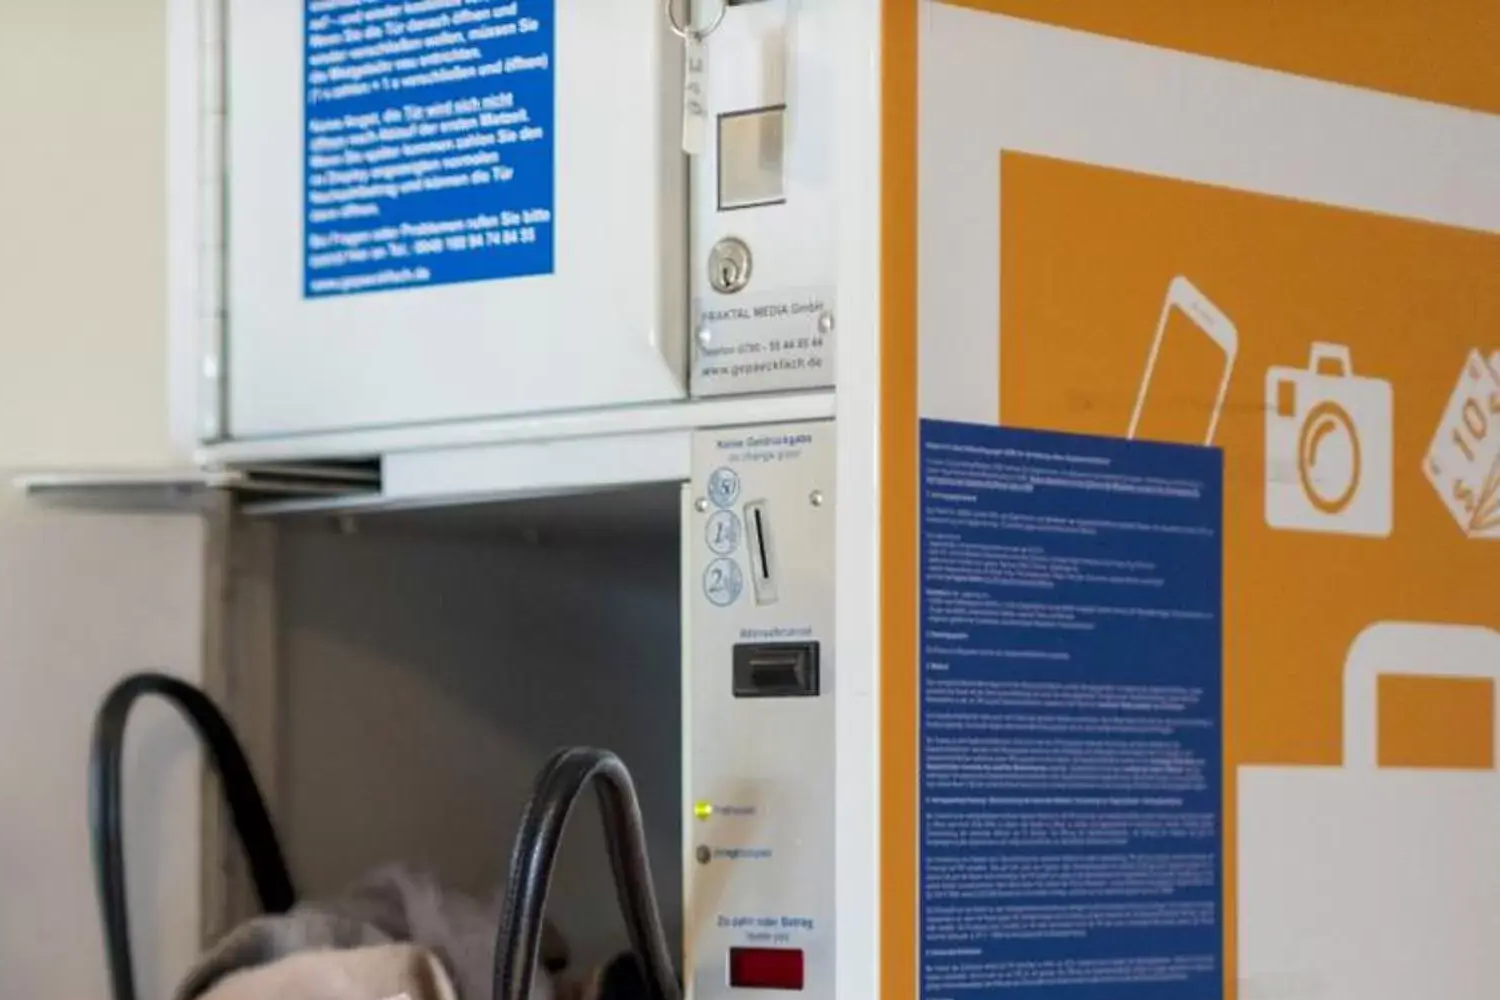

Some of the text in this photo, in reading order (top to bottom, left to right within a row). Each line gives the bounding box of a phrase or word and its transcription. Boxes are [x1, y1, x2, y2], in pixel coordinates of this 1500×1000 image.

[492, 3, 517, 17] und
[468, 24, 516, 39] müssen
[518, 18, 538, 32] Sie
[477, 61, 502, 76] und
[504, 55, 548, 72] öffnen)
[383, 109, 401, 122] die
[404, 106, 426, 120] Tür
[425, 101, 453, 117] wird
[454, 98, 481, 113] sich
[482, 93, 513, 109] nicht
[418, 124, 440, 135] der
[439, 118, 478, 132] ersten
[343, 151, 365, 164] Sie
[456, 134, 497, 149] zahlen
[496, 130, 518, 143] Sie
[519, 127, 542, 140] den
[400, 178, 423, 191] und
[470, 171, 489, 183] die
[493, 167, 513, 180] Tür
[400, 221, 466, 235] Problemen
[501, 212, 522, 226] Sie
[522, 209, 550, 223] bitte
[754, 305, 789, 317] MEDIA
